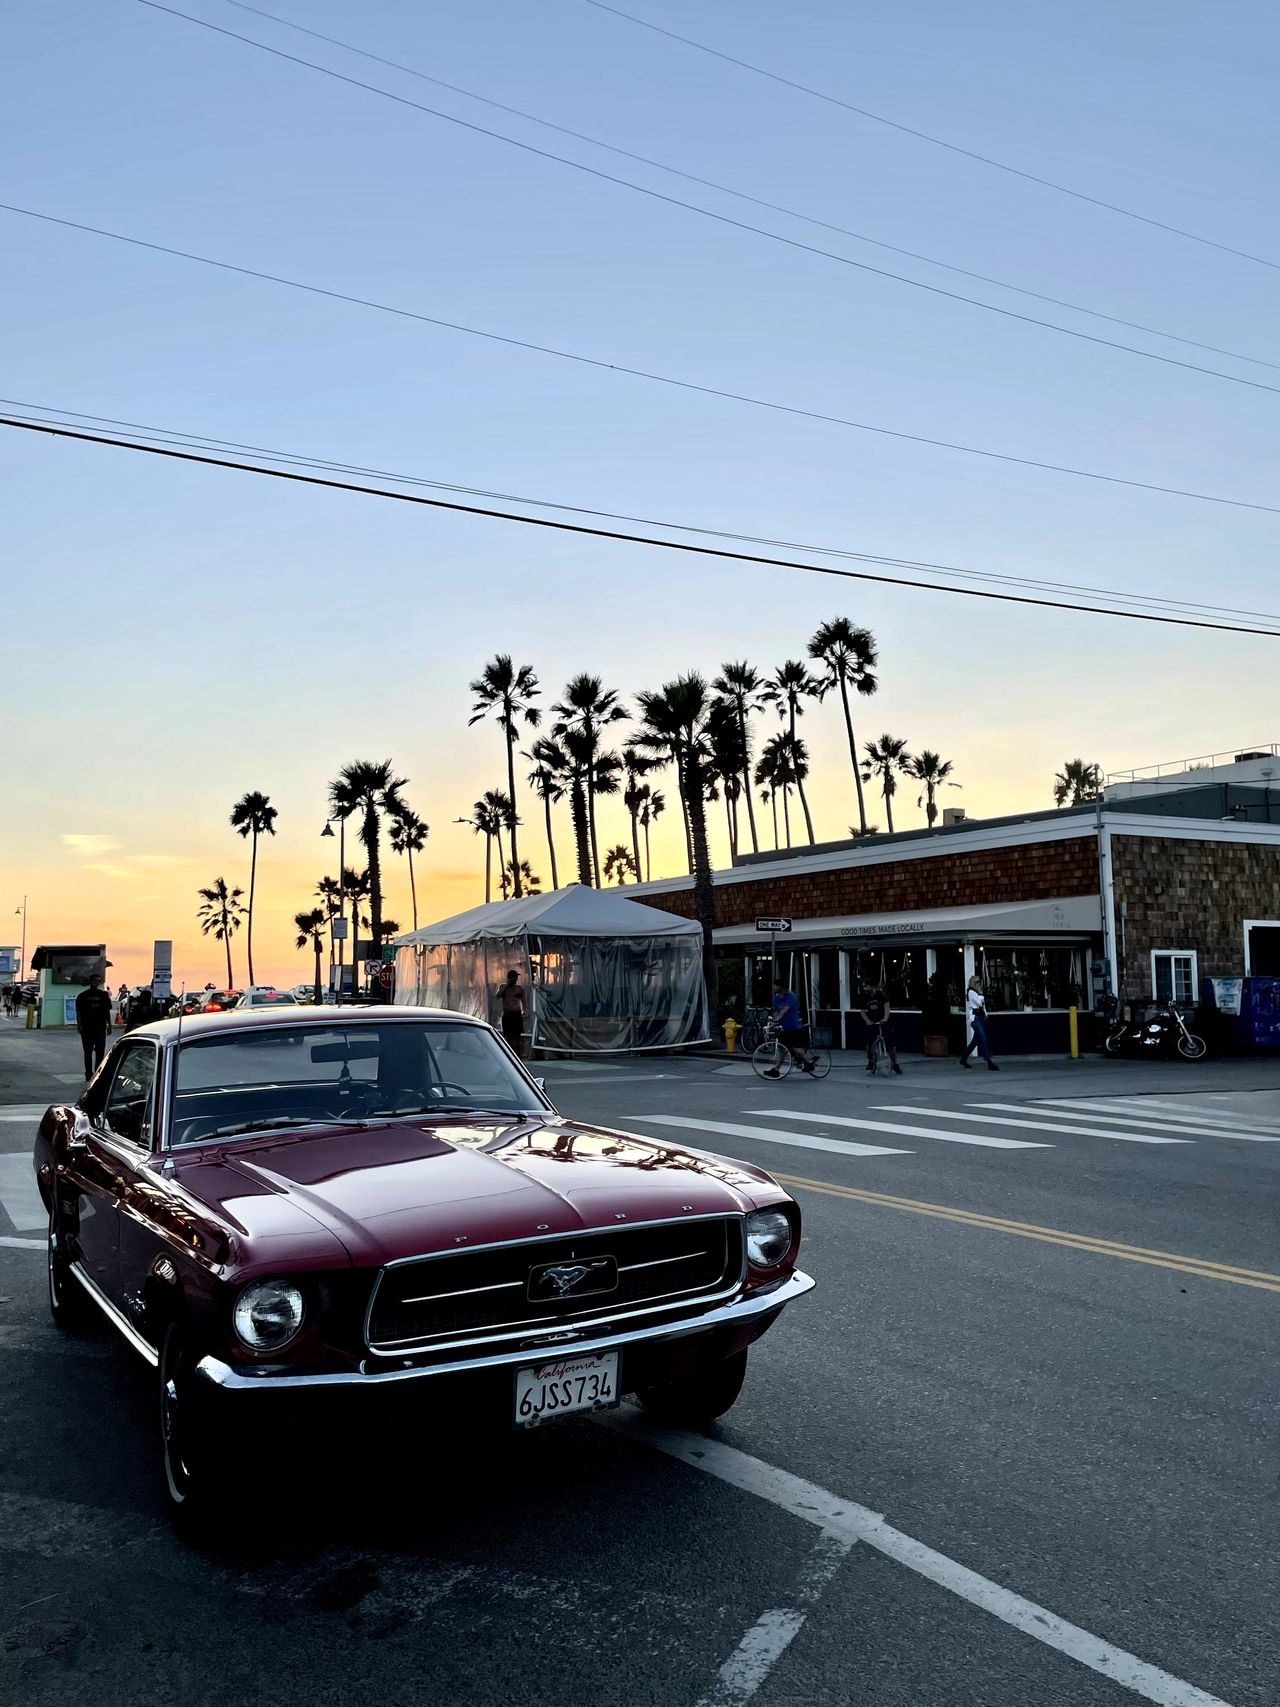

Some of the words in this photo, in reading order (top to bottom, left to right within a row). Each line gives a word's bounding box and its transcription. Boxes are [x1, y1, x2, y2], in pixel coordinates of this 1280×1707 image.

[841, 927, 858, 936] GOOD
[859, 926, 876, 934] TIMES
[878, 925, 896, 933] MADE
[897, 923, 924, 932] LOCALLY
[535, 1360, 601, 1380] California
[519, 1371, 612, 1416] 6JSS734
